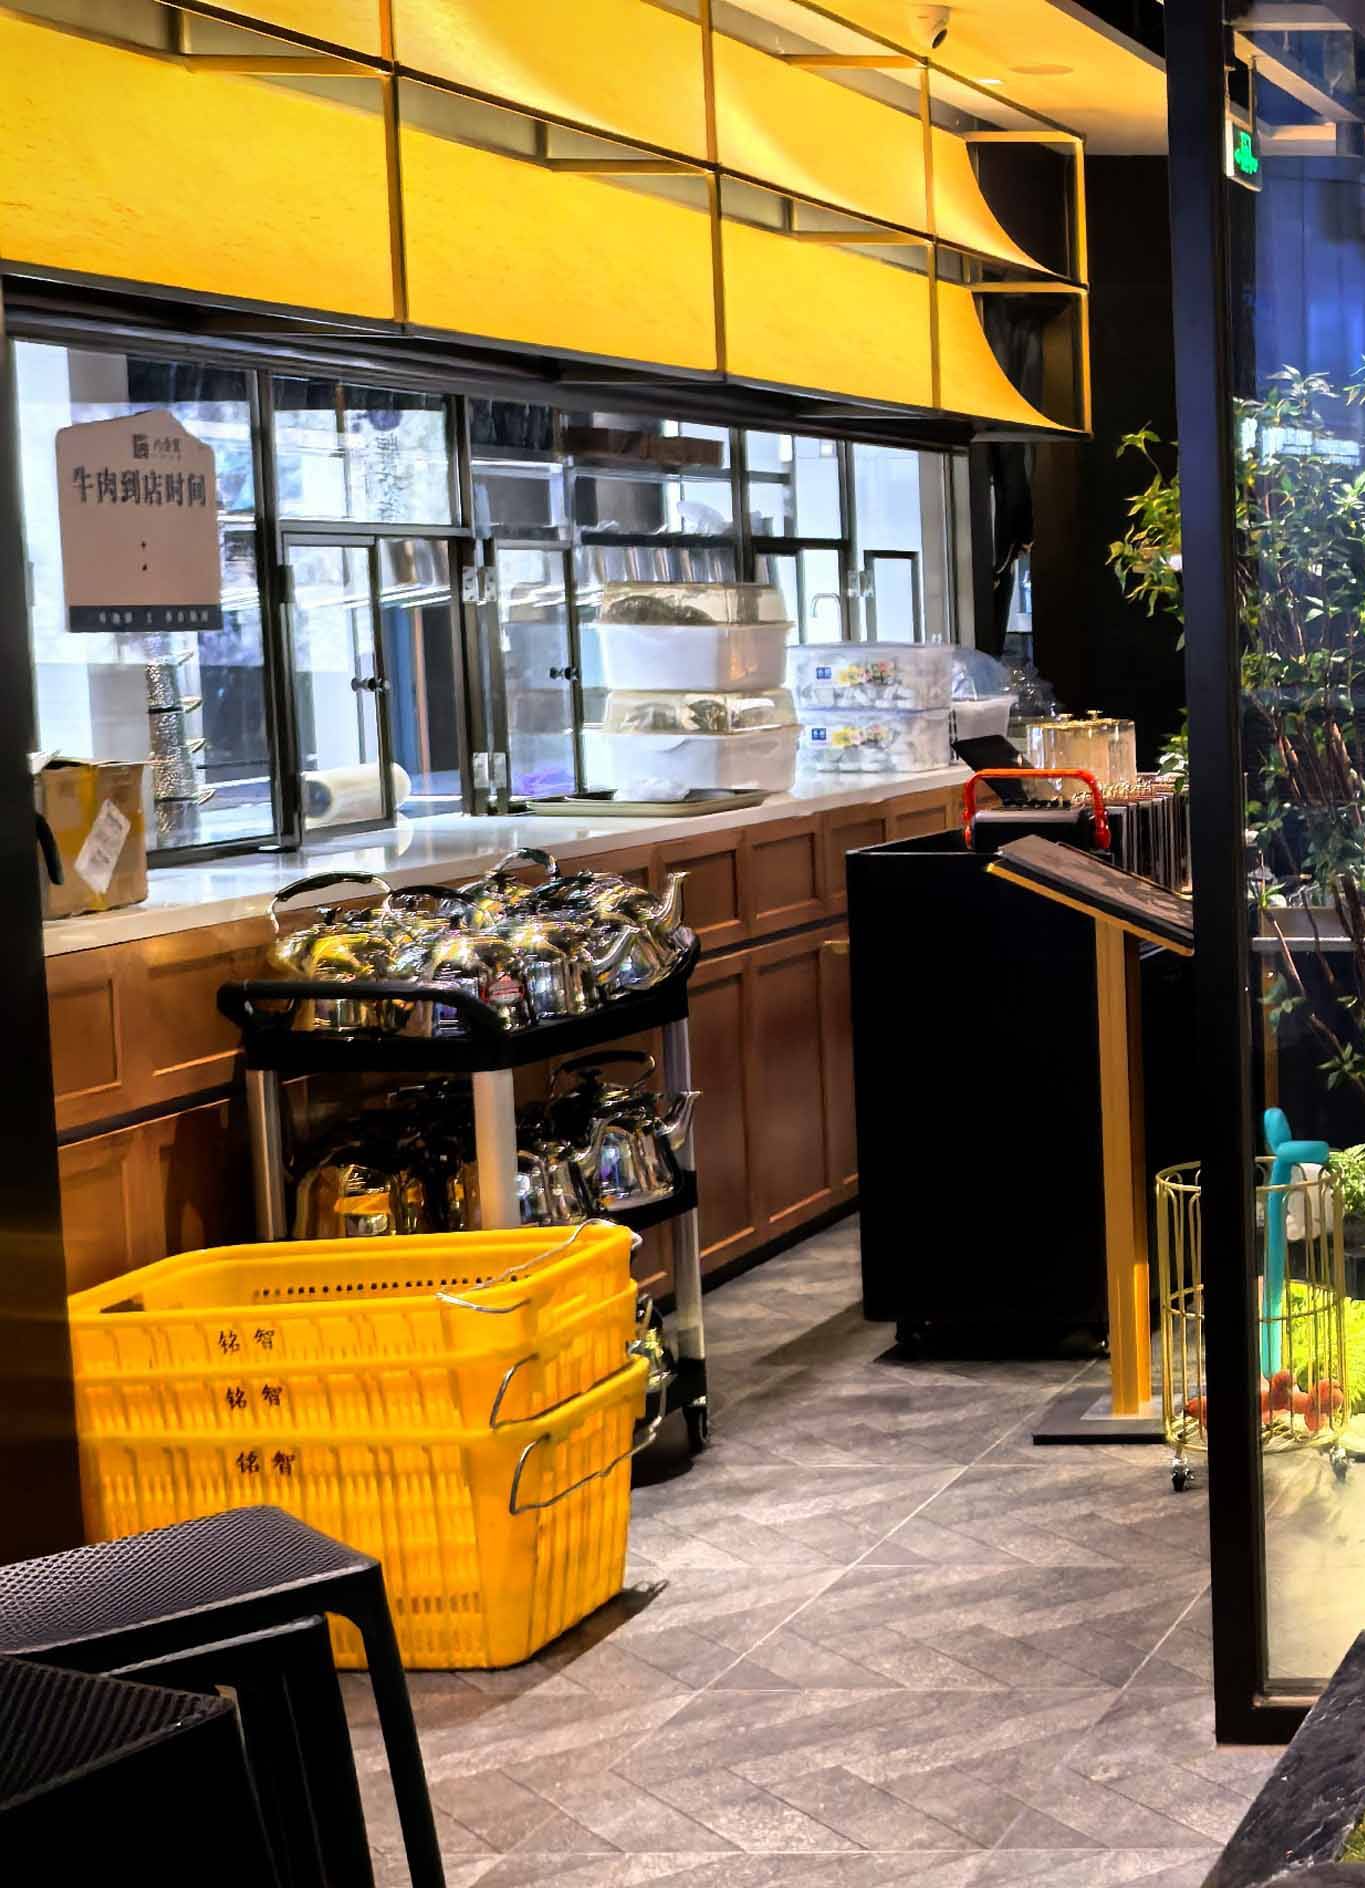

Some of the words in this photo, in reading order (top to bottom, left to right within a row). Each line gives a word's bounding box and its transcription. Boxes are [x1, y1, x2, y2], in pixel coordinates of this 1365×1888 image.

[72, 465, 206, 506] 牛肉到店时间
[218, 1328, 275, 1354] 铭智
[226, 1384, 282, 1409] 铭智
[236, 1450, 296, 1476] 铭智
